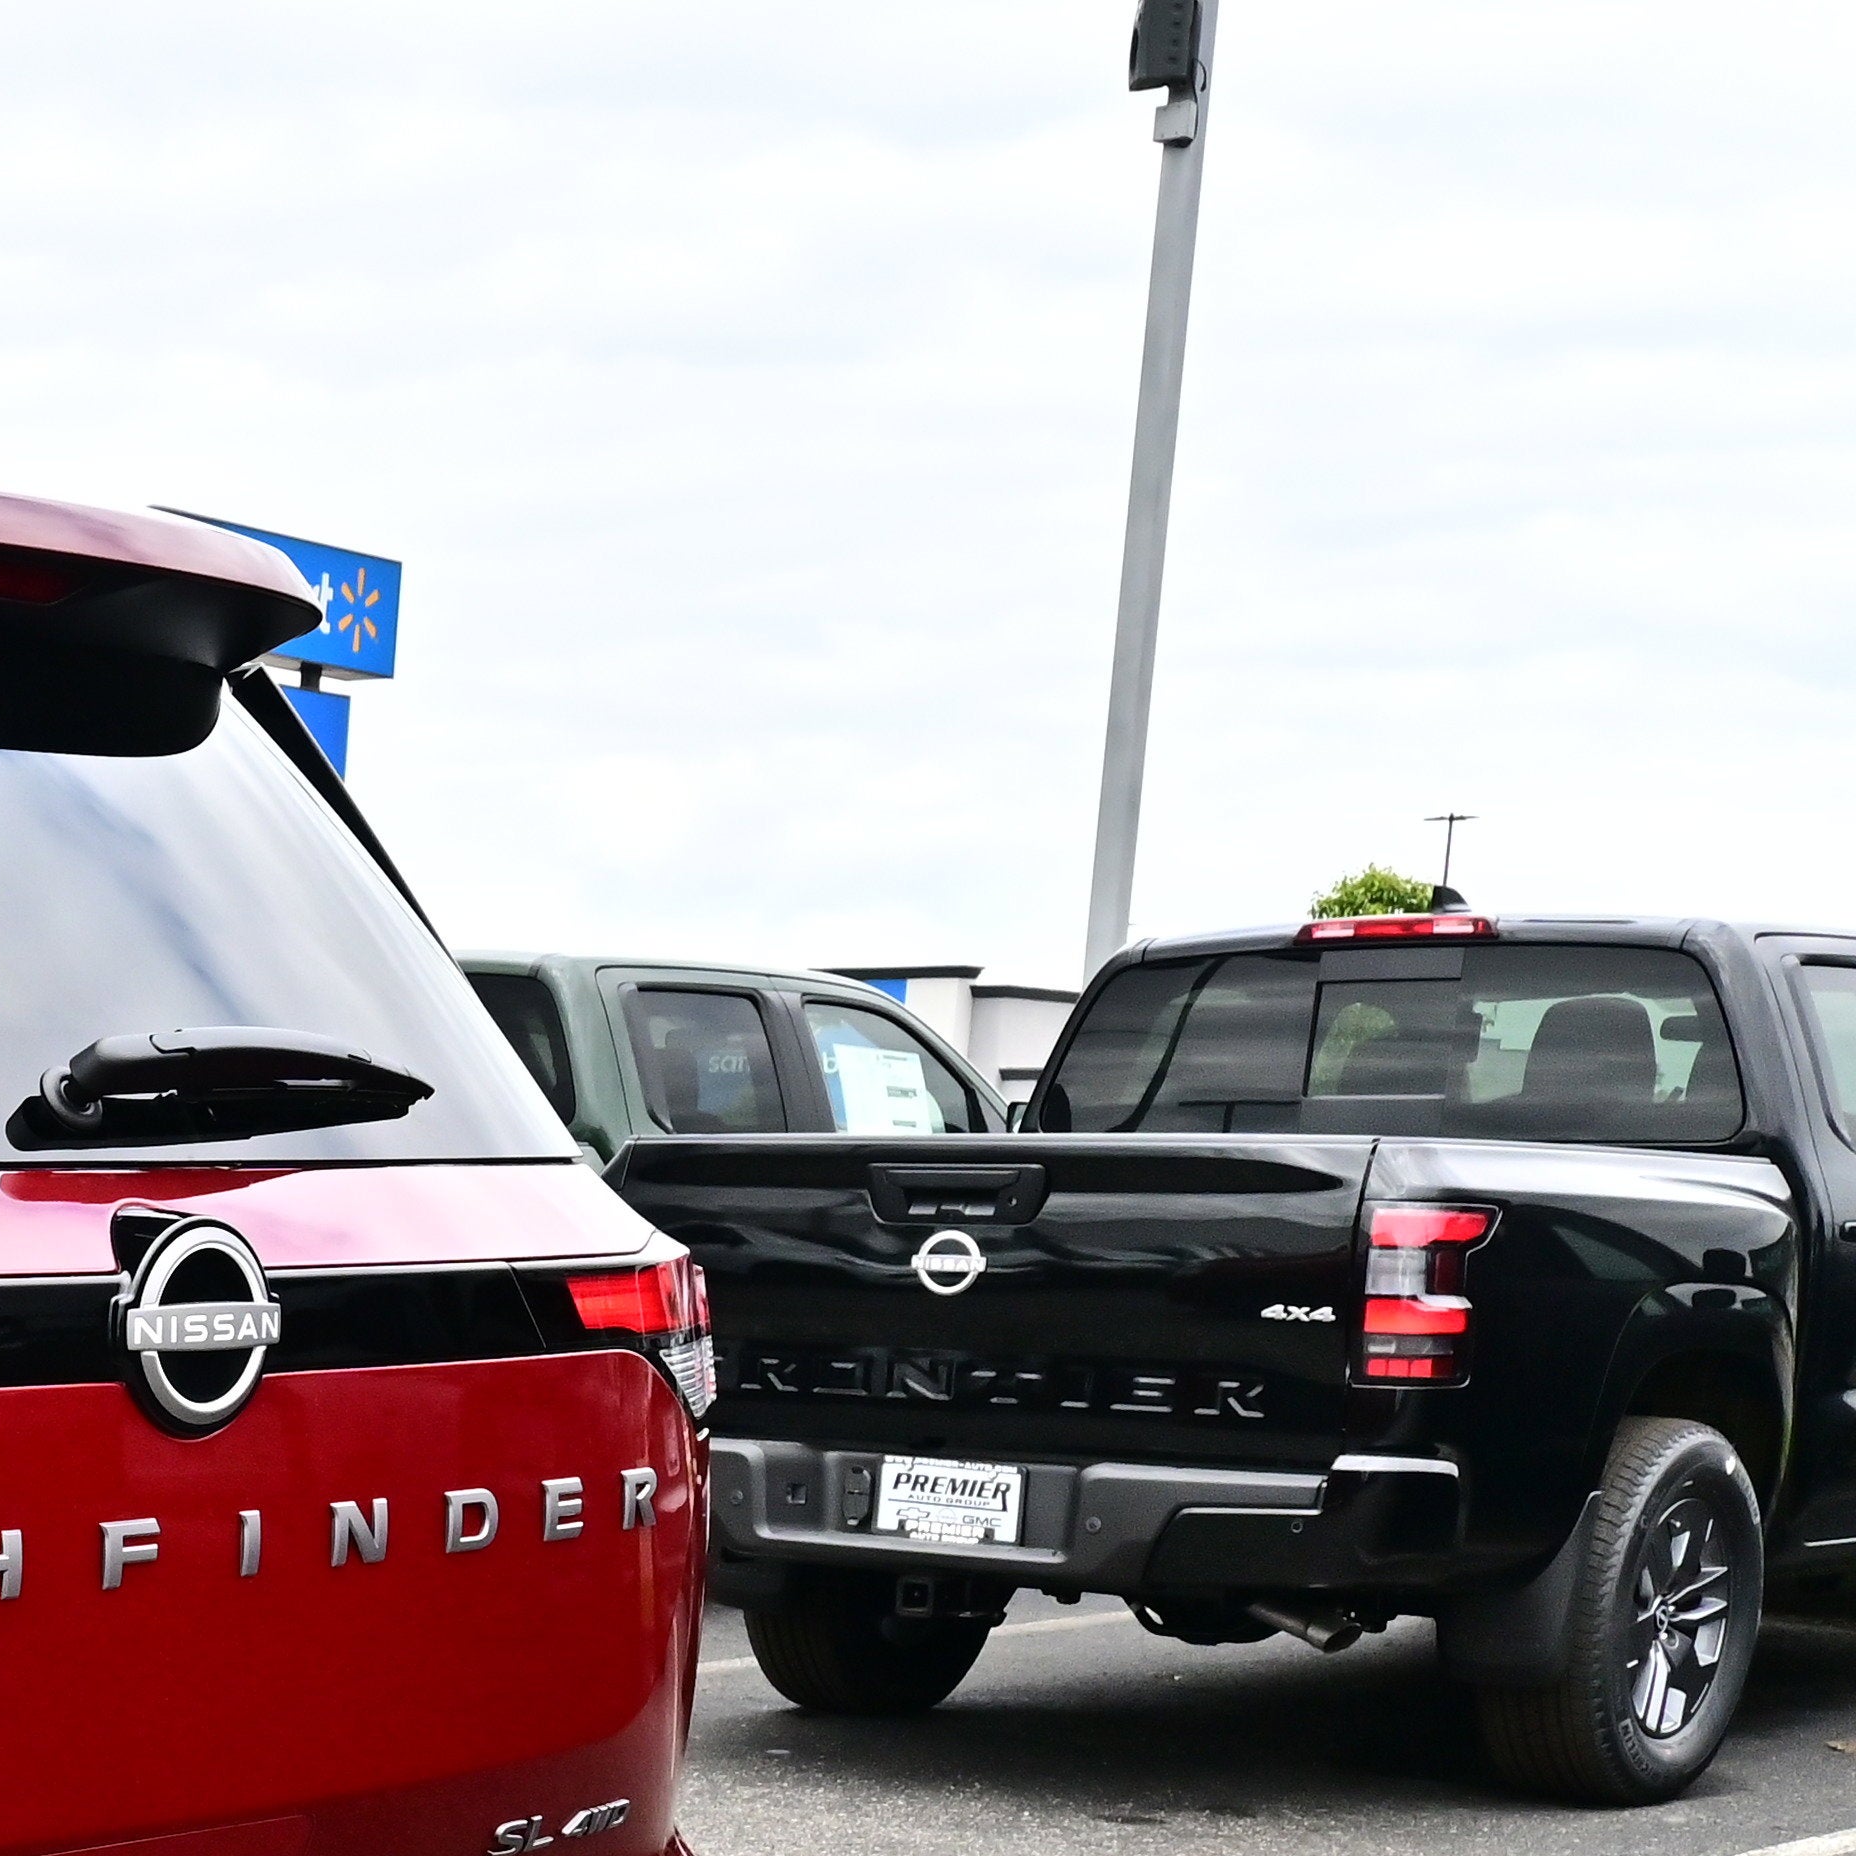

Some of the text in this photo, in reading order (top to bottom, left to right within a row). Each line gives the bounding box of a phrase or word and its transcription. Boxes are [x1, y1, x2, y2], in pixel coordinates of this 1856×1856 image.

[912, 1255, 986, 1272] NISSAN
[133, 1311, 279, 1345] NISSAN
[712, 1353, 1267, 1418] RONTIER
[892, 1472, 1012, 1512] PREMIER
[907, 1494, 991, 1507] AUTO GROUP
[962, 1515, 1002, 1528] GMC
